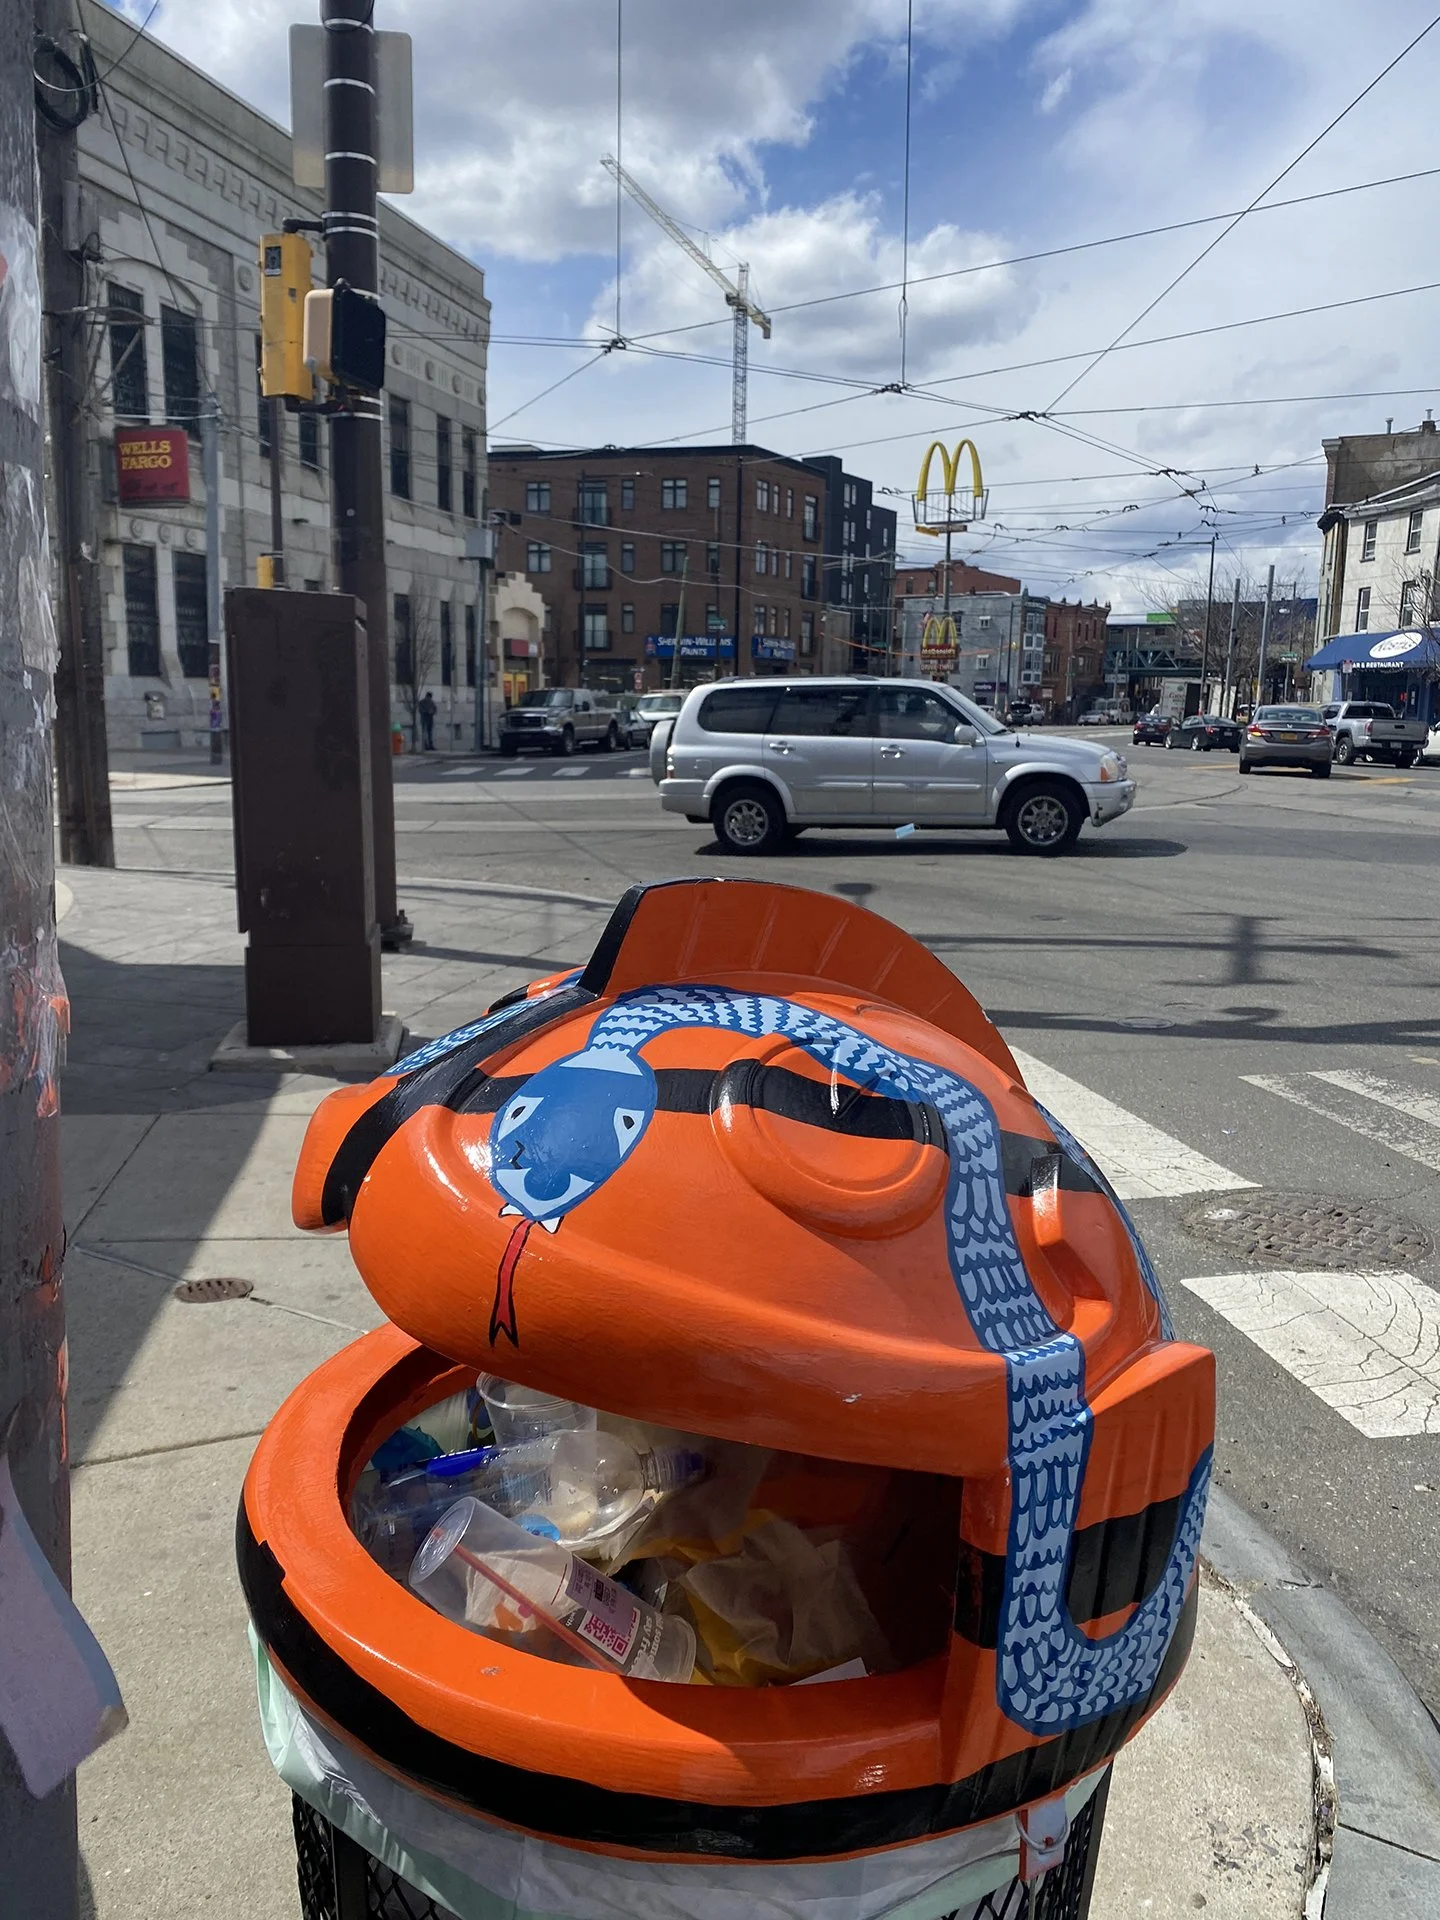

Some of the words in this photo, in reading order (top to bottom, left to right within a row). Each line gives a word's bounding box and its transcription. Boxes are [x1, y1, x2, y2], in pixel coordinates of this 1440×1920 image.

[119, 440, 171, 455] WELLS
[121, 454, 171, 470] FARGO
[680, 646, 707, 656] PAINTS
